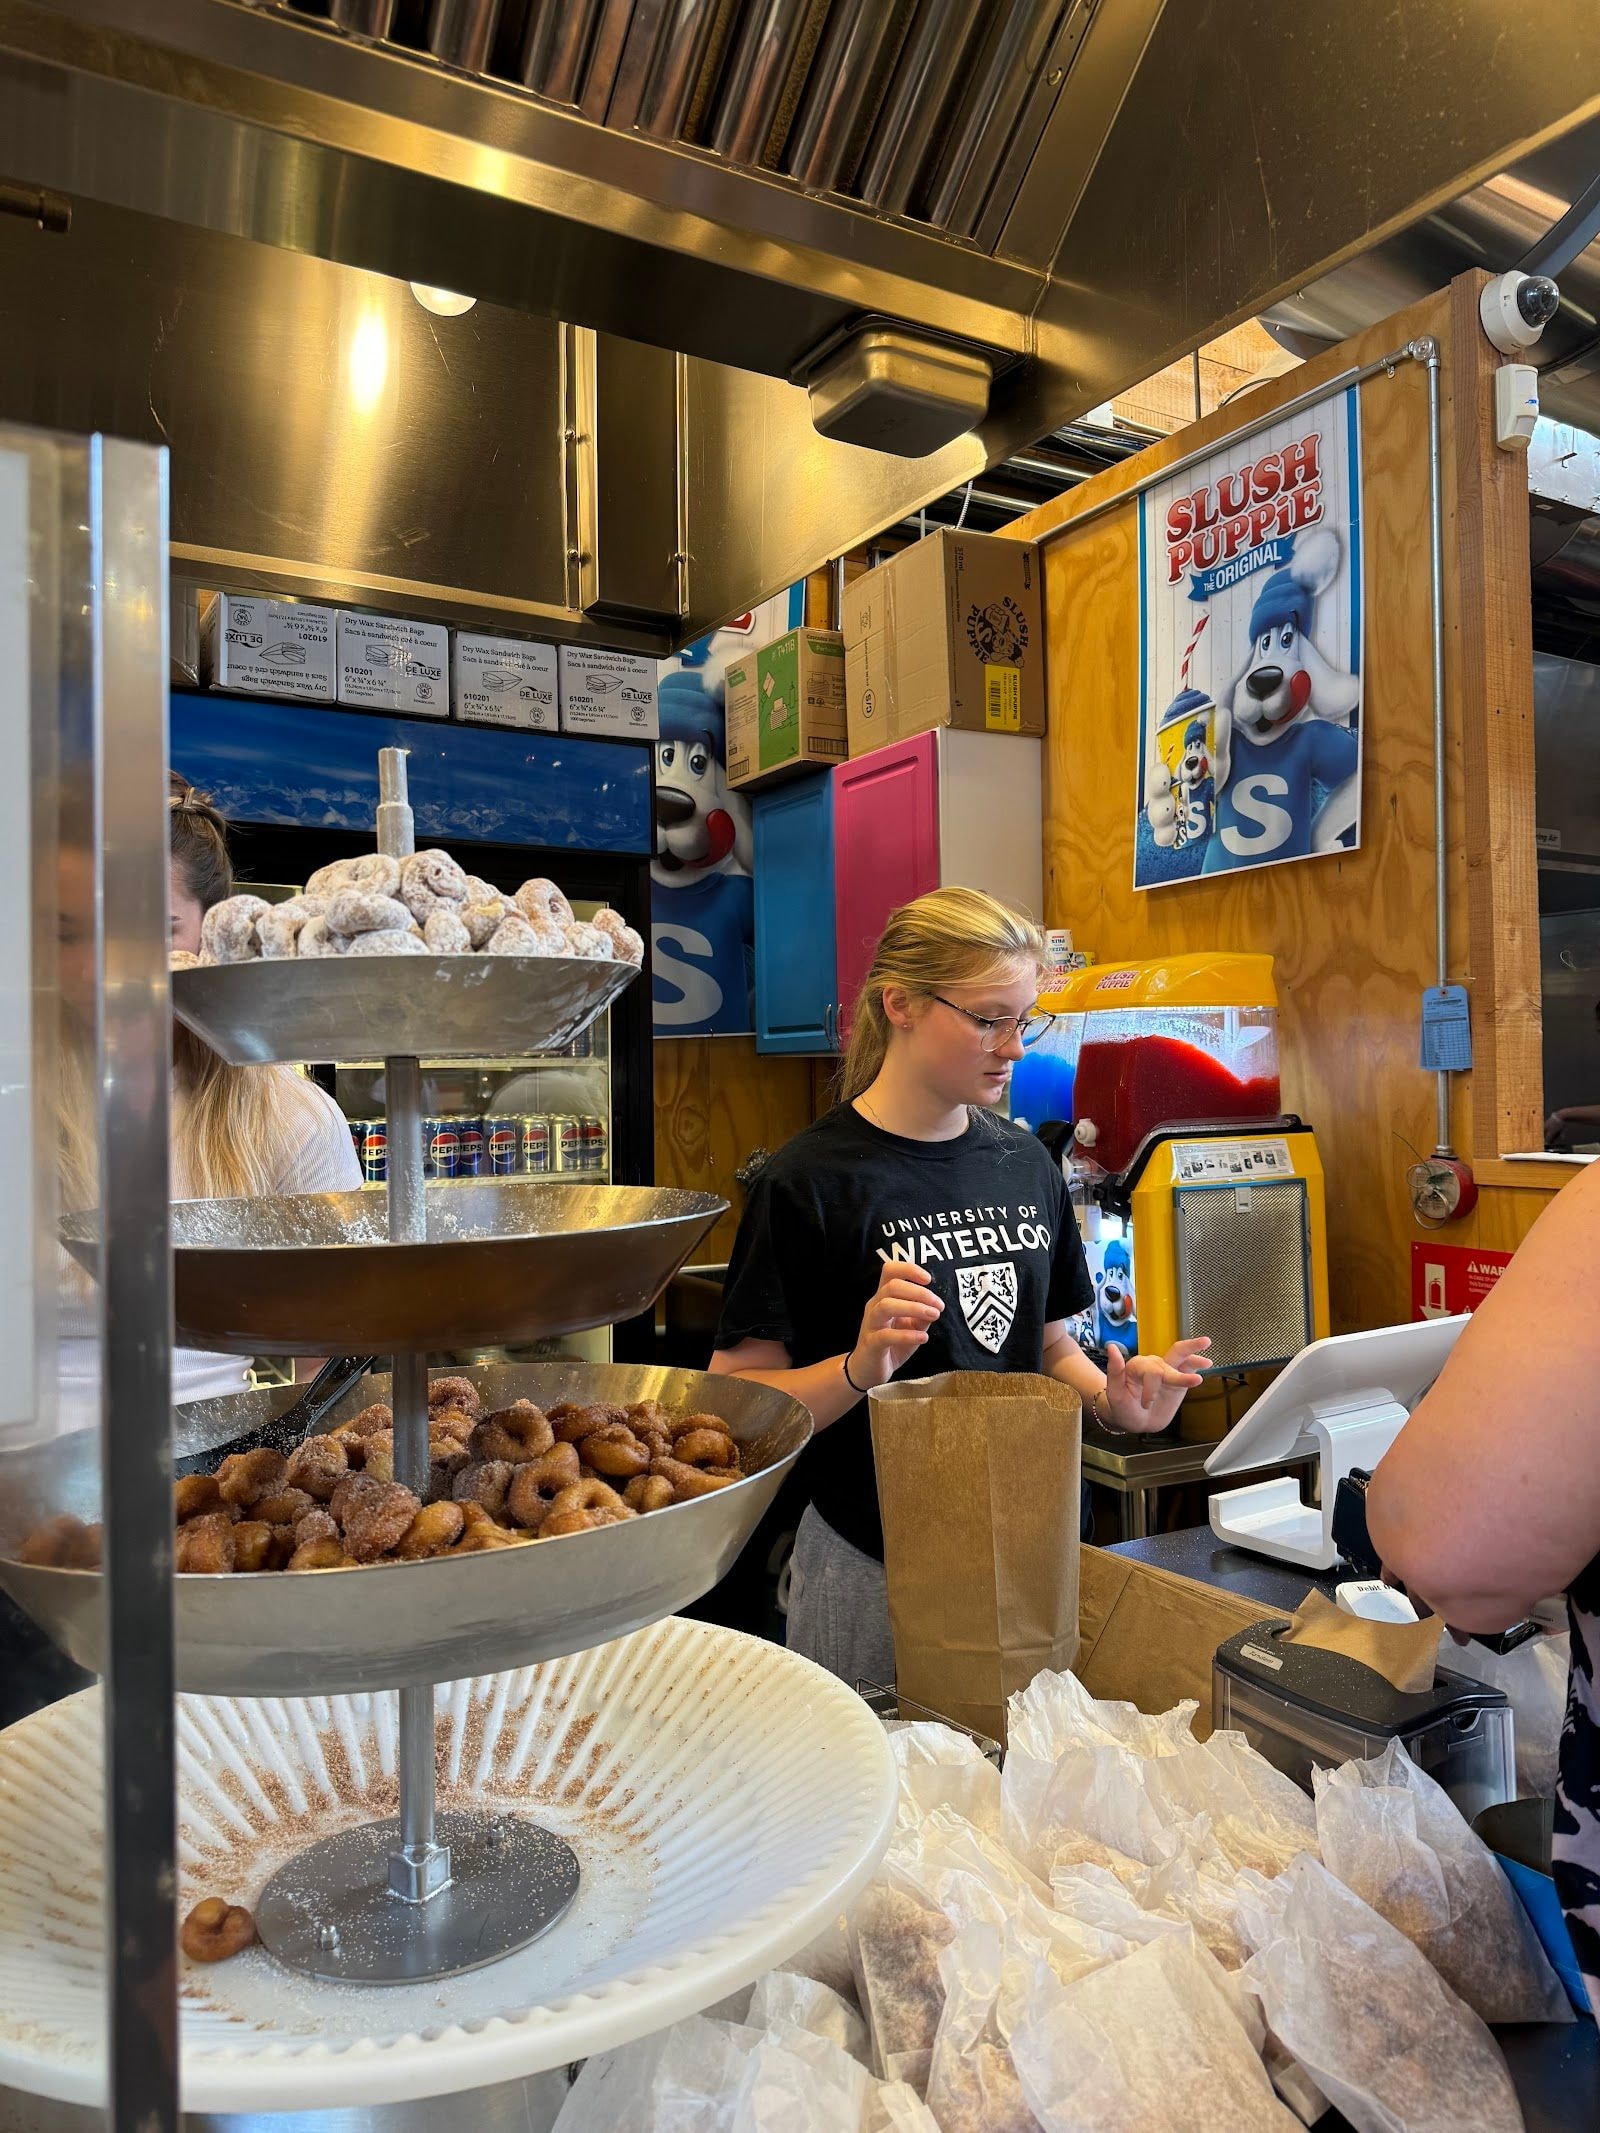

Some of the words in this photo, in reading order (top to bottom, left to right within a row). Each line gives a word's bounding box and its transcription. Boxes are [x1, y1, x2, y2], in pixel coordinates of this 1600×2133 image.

[1166, 433, 1321, 543] SLUSH
[1203, 580, 1215, 592] THE
[1215, 541, 1282, 589] ORIGINAL
[1002, 596, 1029, 648] SLUSH
[345, 618, 357, 626] Dry
[359, 620, 374, 628] Wax
[375, 623, 408, 632] Sandwich
[410, 628, 424, 636] Bags
[225, 633, 247, 641] LUXE
[299, 633, 327, 642] 610201
[368, 632, 399, 641] sandwich
[491, 650, 520, 658] Sandwich
[567, 651, 578, 659] Dry
[594, 654, 621, 662] Sandwich
[345, 667, 372, 676] 610201
[587, 663, 614, 671] sandwich
[270, 668, 304, 677] sandwich
[312, 673, 327, 681] Sacs
[420, 668, 441, 677] LUXE
[241, 675, 258, 684] Bags
[260, 678, 294, 688] Sandwich
[315, 683, 327, 691] Dry
[1220, 773, 1293, 856] S
[1186, 801, 1206, 839] S
[651, 922, 723, 1025] S
[1102, 971, 1139, 981] SLUSH
[490, 1143, 516, 1151] PEPS
[523, 1142, 548, 1150] PEPS
[362, 1148, 388, 1156] PEPS
[882, 1206, 1008, 1237] UNIVERSITY
[1018, 1205, 1038, 1219] OF
[875, 1222, 1051, 1265] WATERLOO
